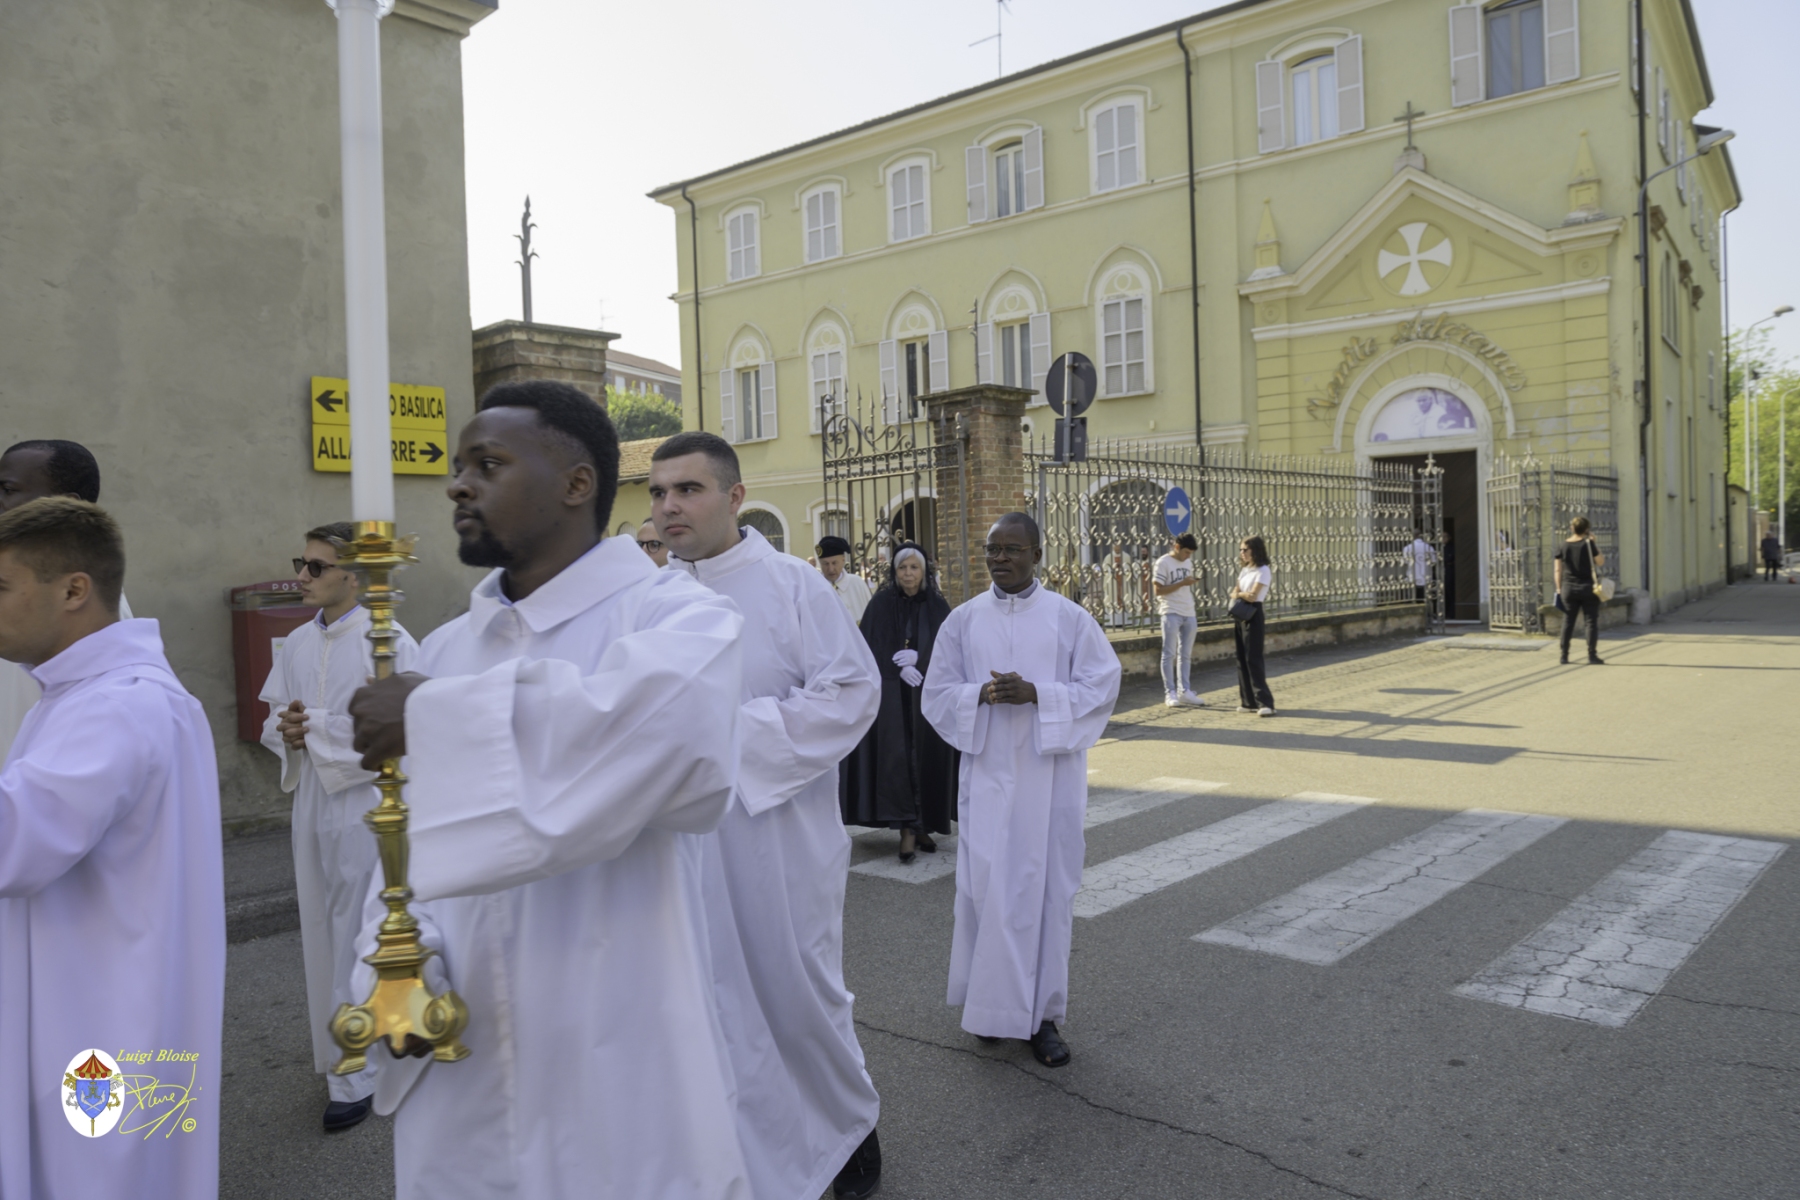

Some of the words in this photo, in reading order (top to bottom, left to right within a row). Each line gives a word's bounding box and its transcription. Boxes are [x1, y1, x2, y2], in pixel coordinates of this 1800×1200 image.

[400, 395, 444, 419] BASILICA
[391, 440, 416, 462] RRE
[272, 582, 303, 591] POS
